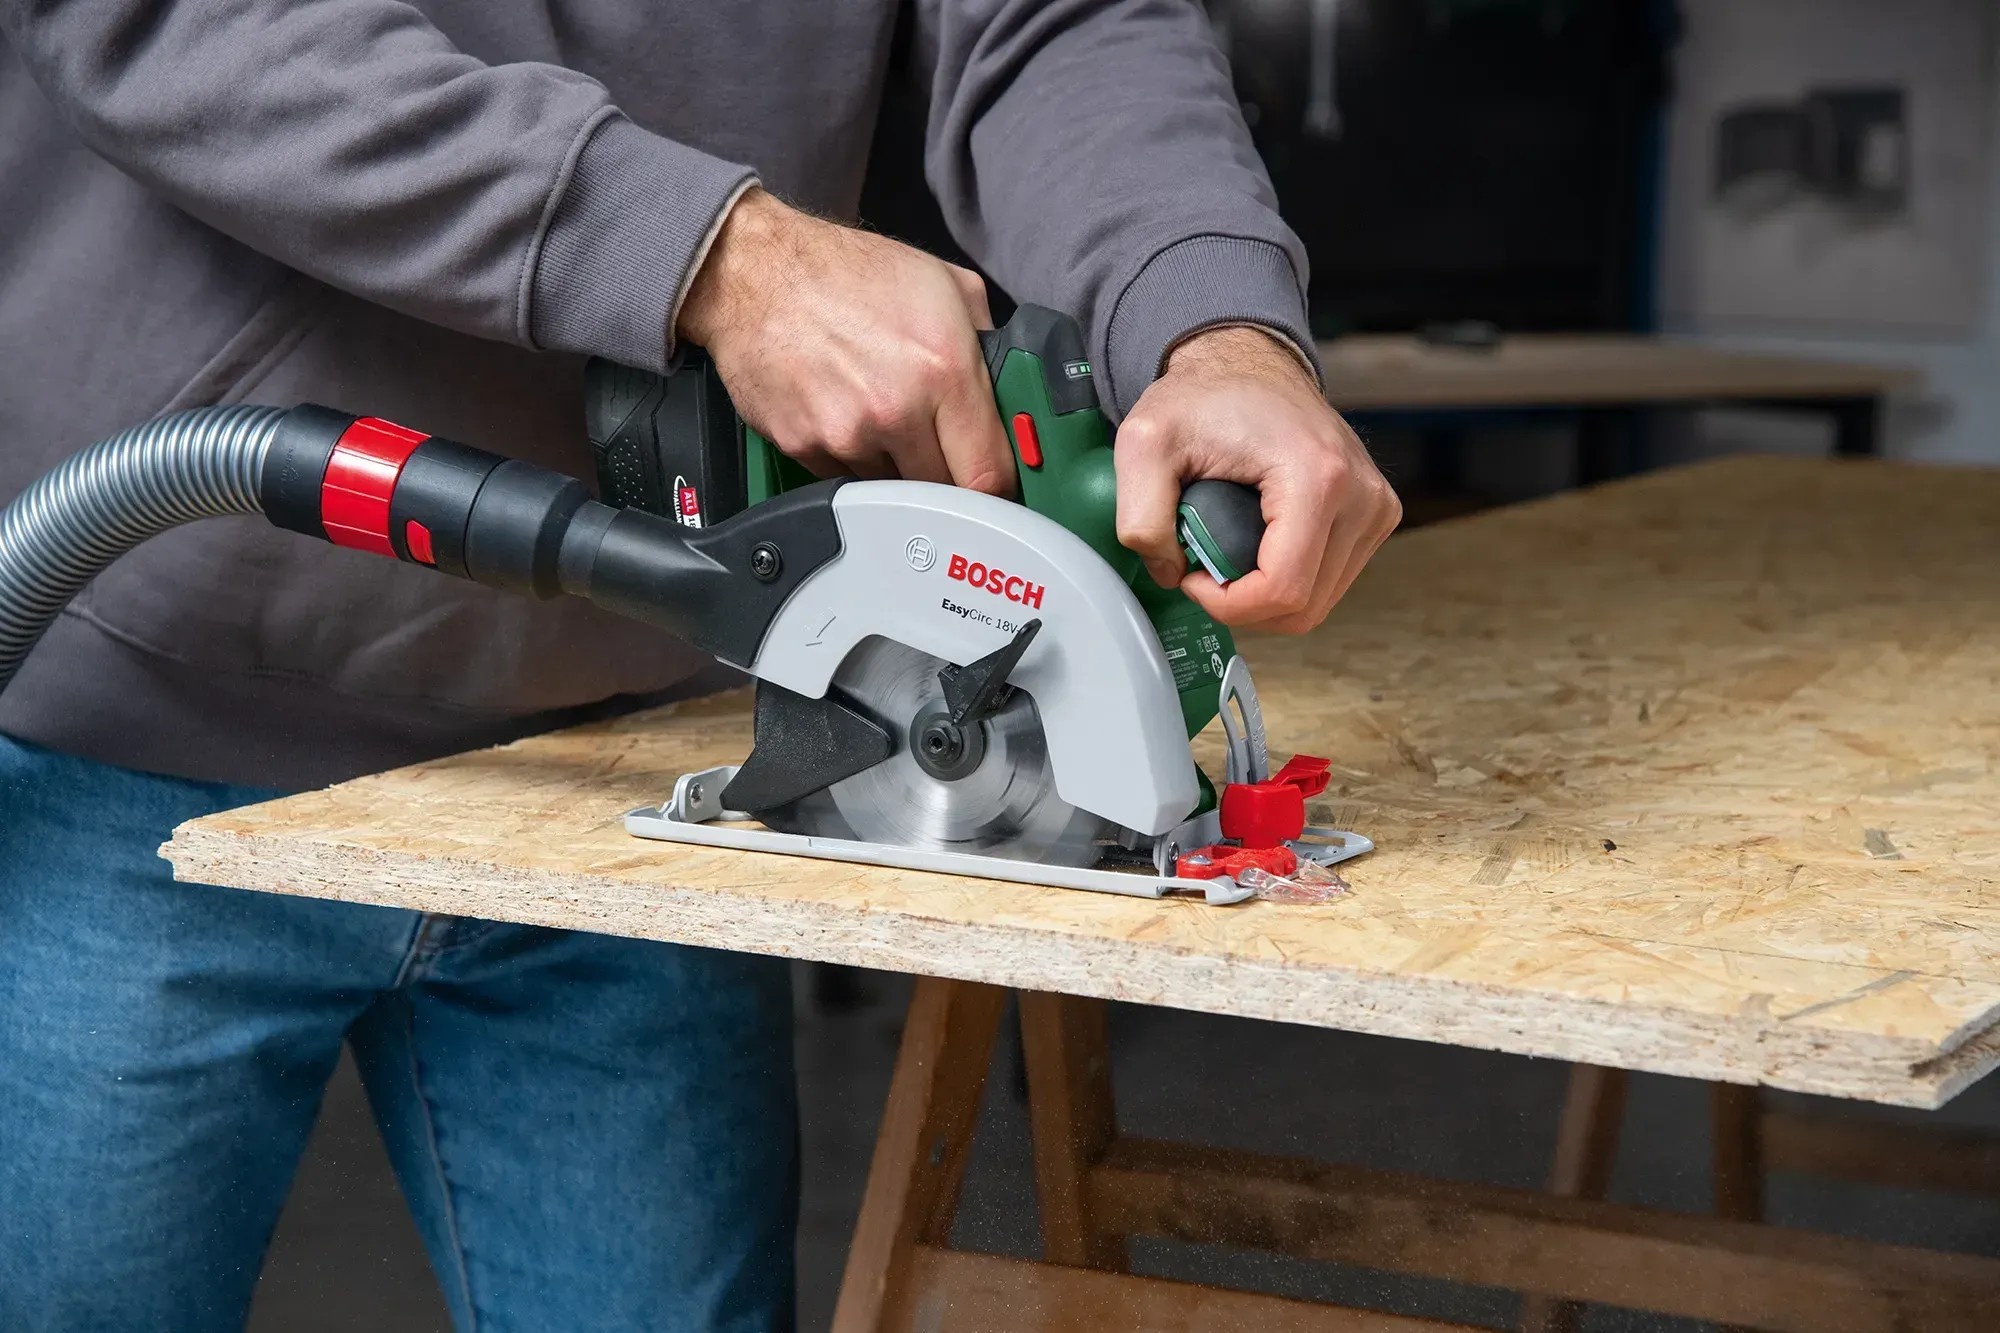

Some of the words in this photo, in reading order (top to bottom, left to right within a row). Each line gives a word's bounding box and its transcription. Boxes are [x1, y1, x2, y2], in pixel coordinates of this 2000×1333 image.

[684, 491, 694, 513] ALL
[947, 552, 1045, 610] BOSCH
[941, 598, 993, 626] EasyCirc
